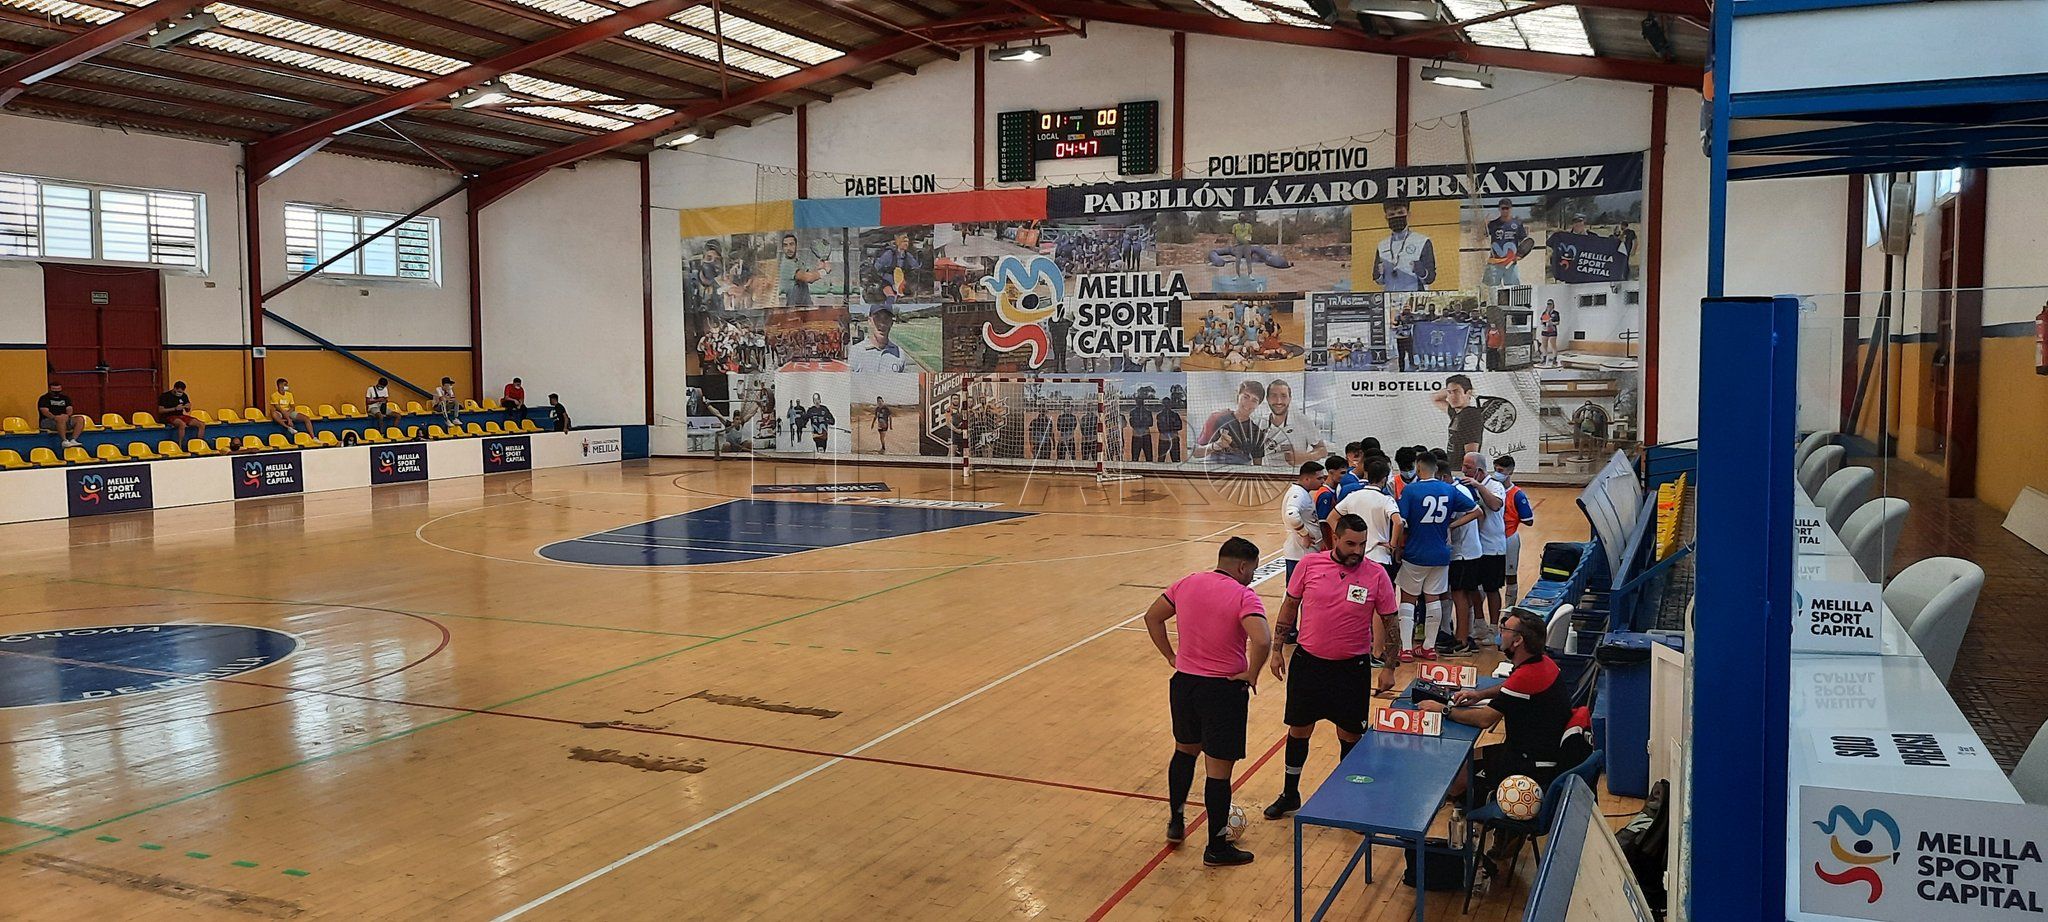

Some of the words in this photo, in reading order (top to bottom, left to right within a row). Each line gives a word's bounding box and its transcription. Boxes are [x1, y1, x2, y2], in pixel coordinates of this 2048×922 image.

[1097, 109, 1117, 126] 00
[1037, 133, 1060, 141] LOCAL
[1092, 128, 1116, 137] VISITANTE
[1055, 140, 1098, 158] 04:47
[1208, 147, 1368, 177] POLIDEPORTIVO
[845, 174, 935, 196] PABELLON
[1083, 182, 1239, 214] PABELLÓN
[1243, 179, 1379, 207] LÁZARO
[1386, 165, 1604, 199] FERNÁNDEZ
[1578, 258, 1606, 268] SPORT
[1579, 251, 1614, 263] MELILLA
[1576, 265, 1610, 277] CAPITAL
[1078, 273, 1190, 299] MELILLA
[1078, 302, 1168, 327] SPORT
[1078, 329, 1189, 354] CAPITAL
[1351, 381, 1374, 391] URI
[1379, 381, 1442, 391] BOTELLO
[592, 444, 620, 454] MELILLA
[265, 463, 293, 471] MELILLA
[265, 470, 289, 478] SPORT
[397, 465, 421, 473] CAPITAL
[107, 476, 140, 485] MELILLA
[266, 477, 294, 485] CAPITAL
[107, 484, 135, 493] SPORT
[107, 491, 142, 500] CAPITAL
[1420, 495, 1449, 523] 25
[1811, 599, 1874, 612] MELILLA
[1811, 611, 1862, 624] SPORT
[1810, 624, 1874, 638] CAPITAL
[82, 685, 140, 699] DE
[1379, 709, 1410, 731] 5
[1830, 736, 1880, 758] SOLO
[1891, 733, 1951, 768] PRENSA
[1917, 831, 2043, 863] MELILLA
[1917, 855, 2019, 885] SPORT
[1916, 880, 2044, 913] CAPITAL
